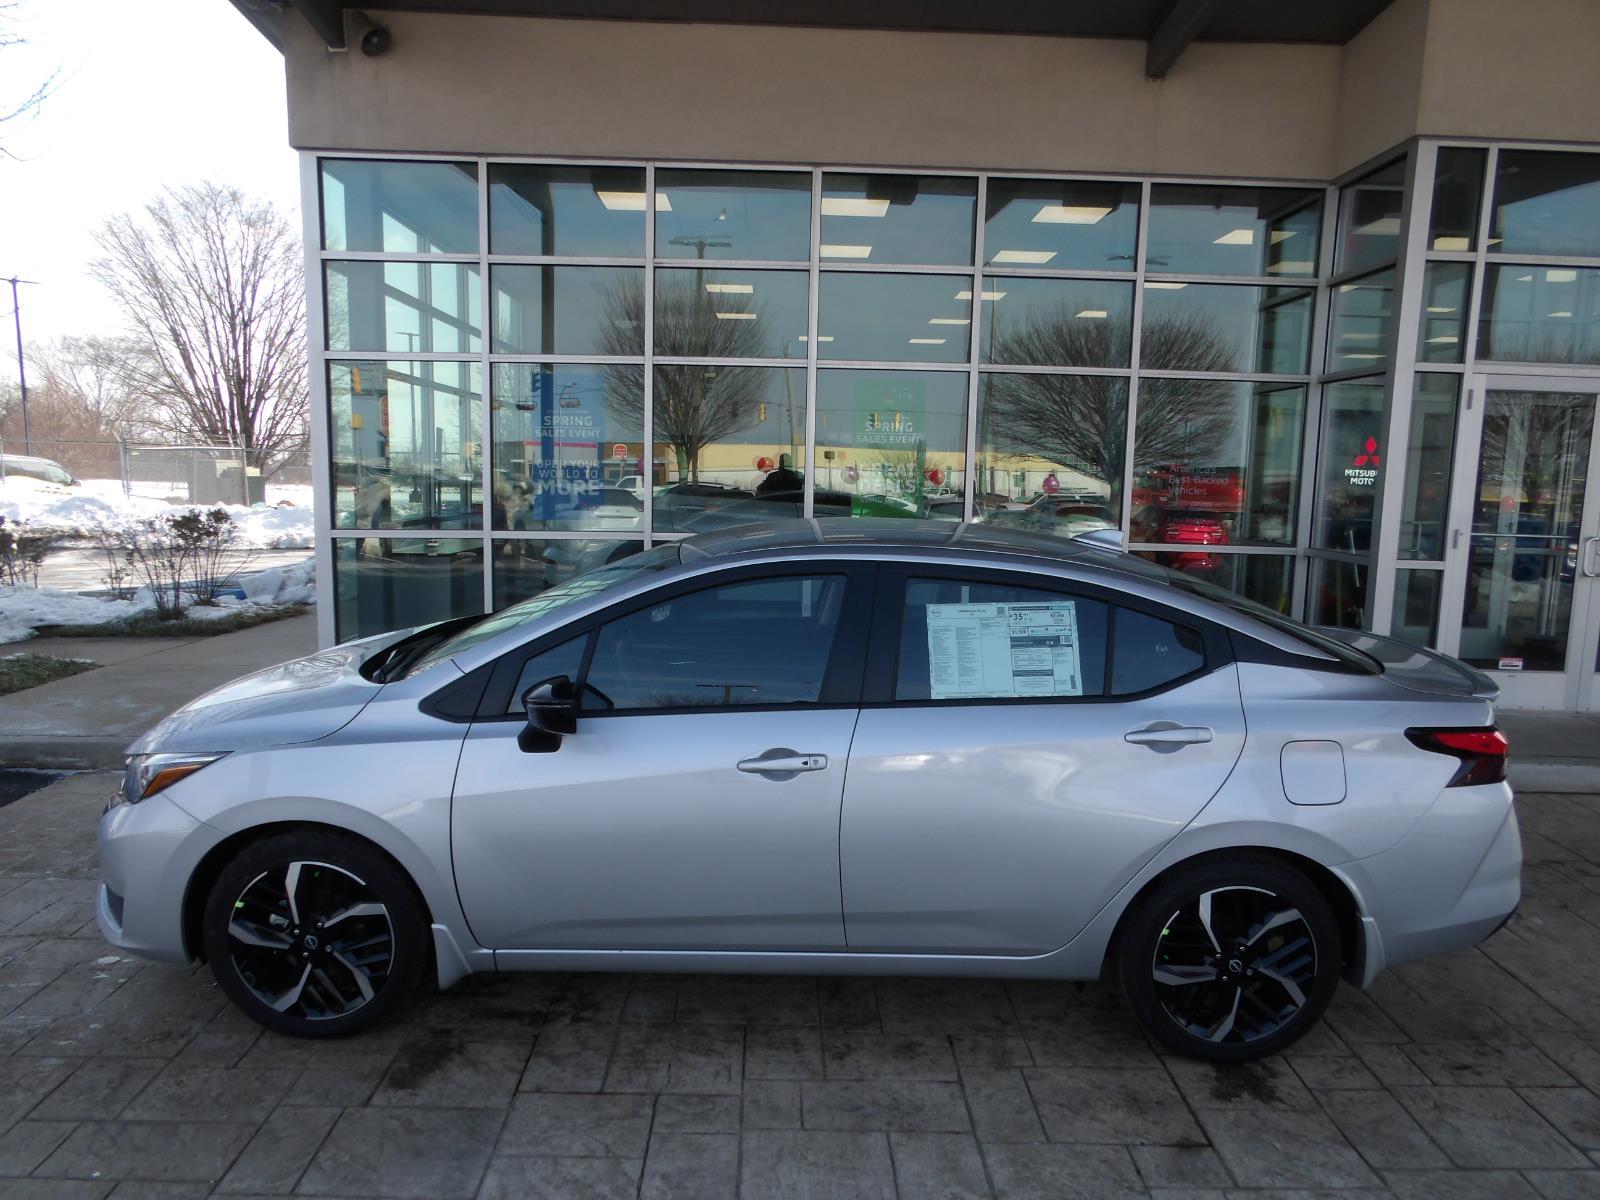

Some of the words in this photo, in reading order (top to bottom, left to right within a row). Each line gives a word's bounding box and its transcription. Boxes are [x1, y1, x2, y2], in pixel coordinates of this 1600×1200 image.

[543, 415, 593, 427] SPRING
[865, 421, 913, 433] SPRING
[535, 429, 567, 438] SALES
[569, 429, 600, 438] EVENT
[855, 434, 887, 443] SALES
[889, 434, 921, 445] EVENT
[539, 469, 580, 479] WORLD
[585, 469, 599, 479] TO
[536, 480, 600, 496] MORE
[1168, 486, 1207, 496] Vehicles
